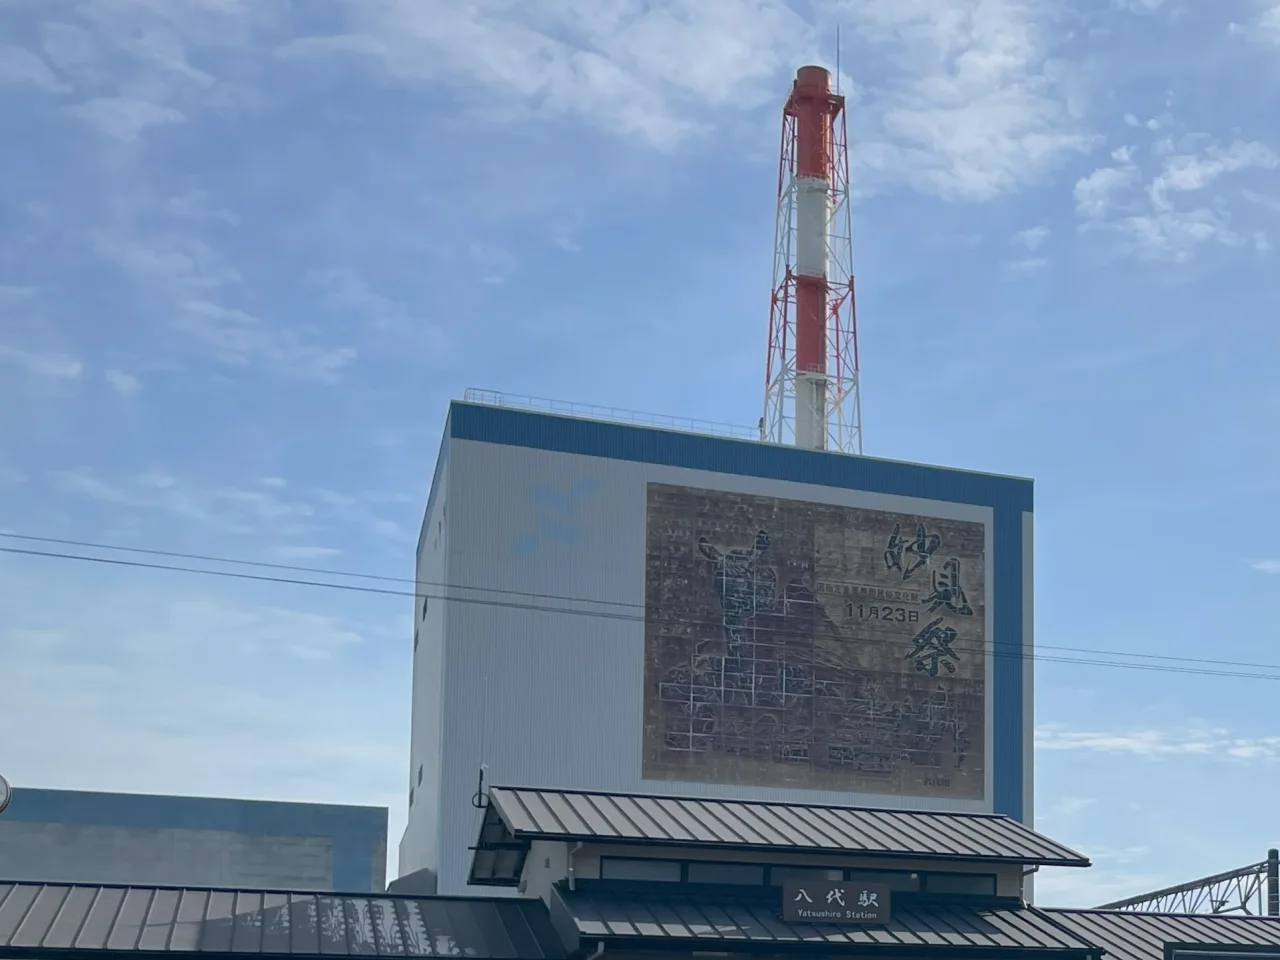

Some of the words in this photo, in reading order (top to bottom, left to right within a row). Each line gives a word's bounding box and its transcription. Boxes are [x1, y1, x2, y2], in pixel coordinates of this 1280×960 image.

[845, 602, 920, 623] 11月23日
[794, 888, 879, 907] 八代駅
[797, 909, 842, 918] Yatsushiro
[846, 910, 877, 919] Station
